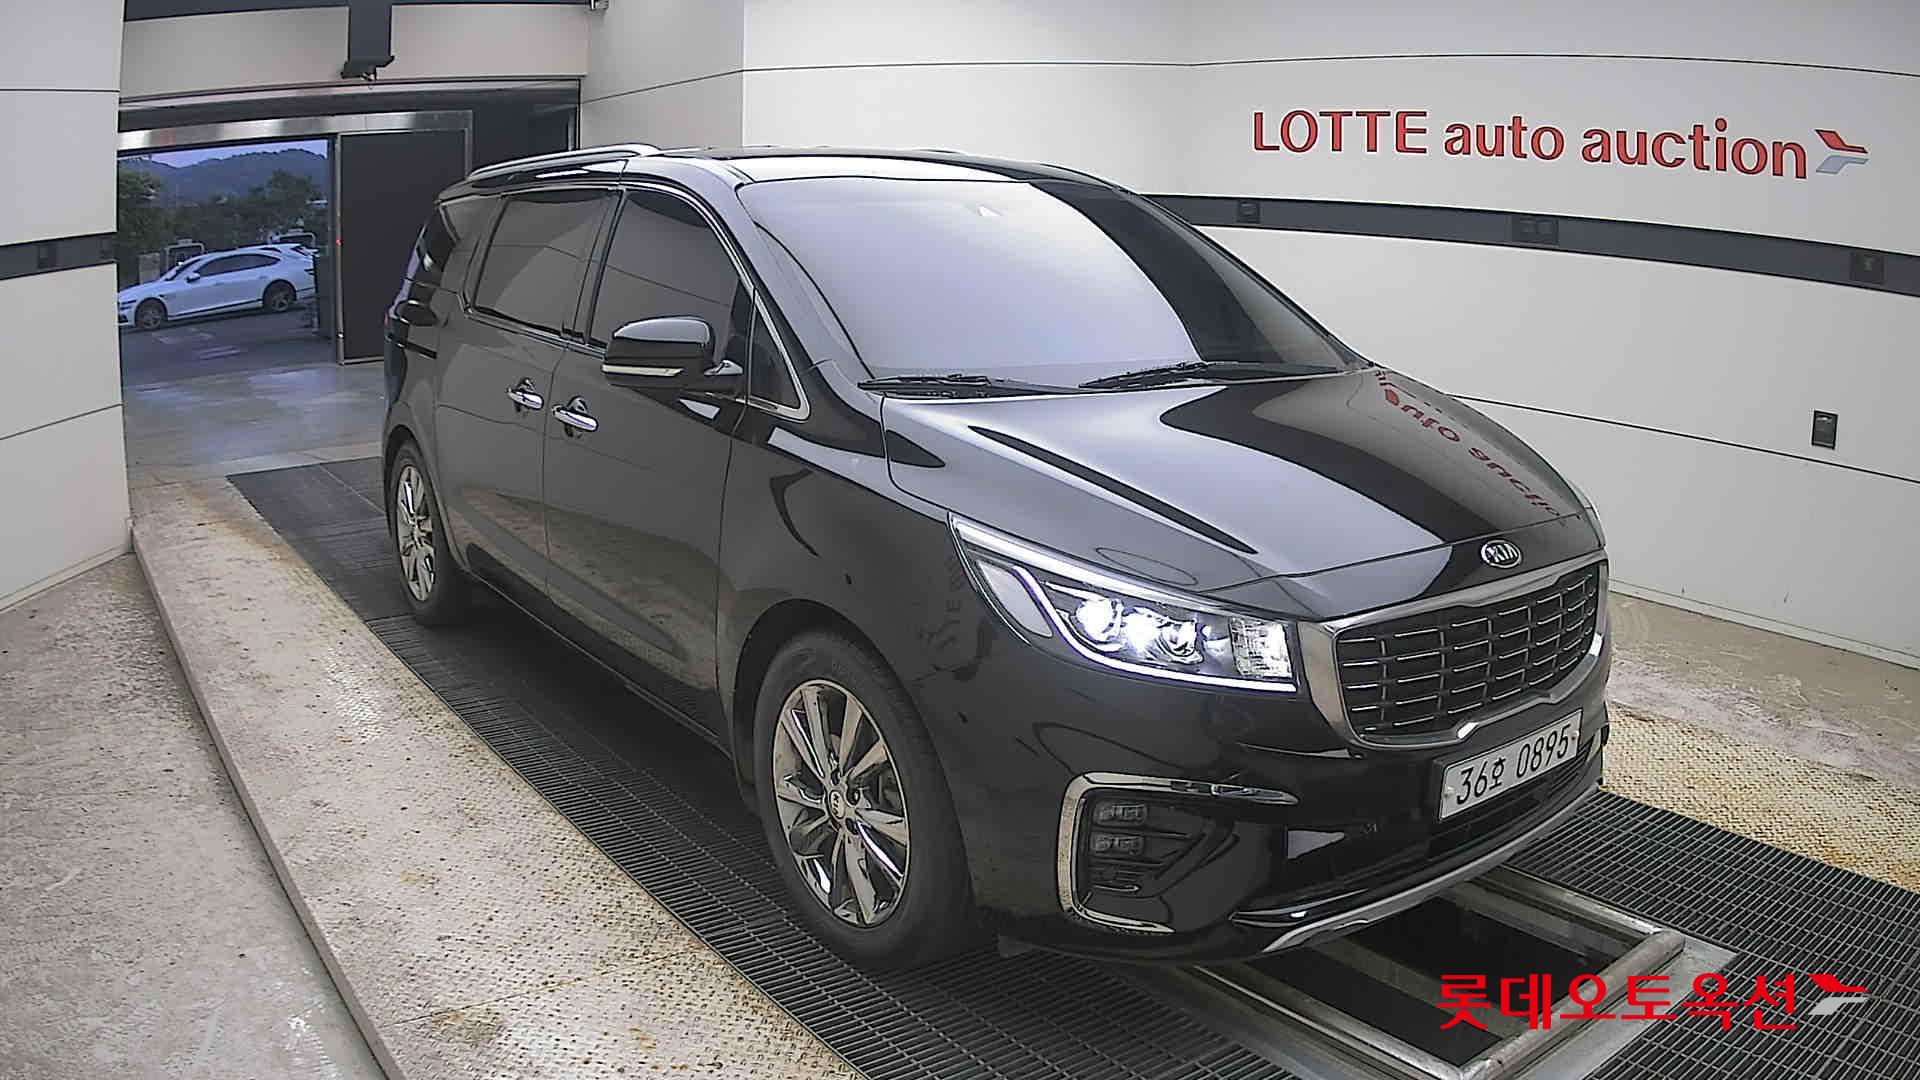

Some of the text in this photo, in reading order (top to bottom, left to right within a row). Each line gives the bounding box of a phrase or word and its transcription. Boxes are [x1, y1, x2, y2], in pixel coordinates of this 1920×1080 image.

[1253, 110, 1808, 178] LOTTE auto auction
[1485, 542, 1519, 564] KIA
[1457, 723, 1571, 805] 36호 0895
